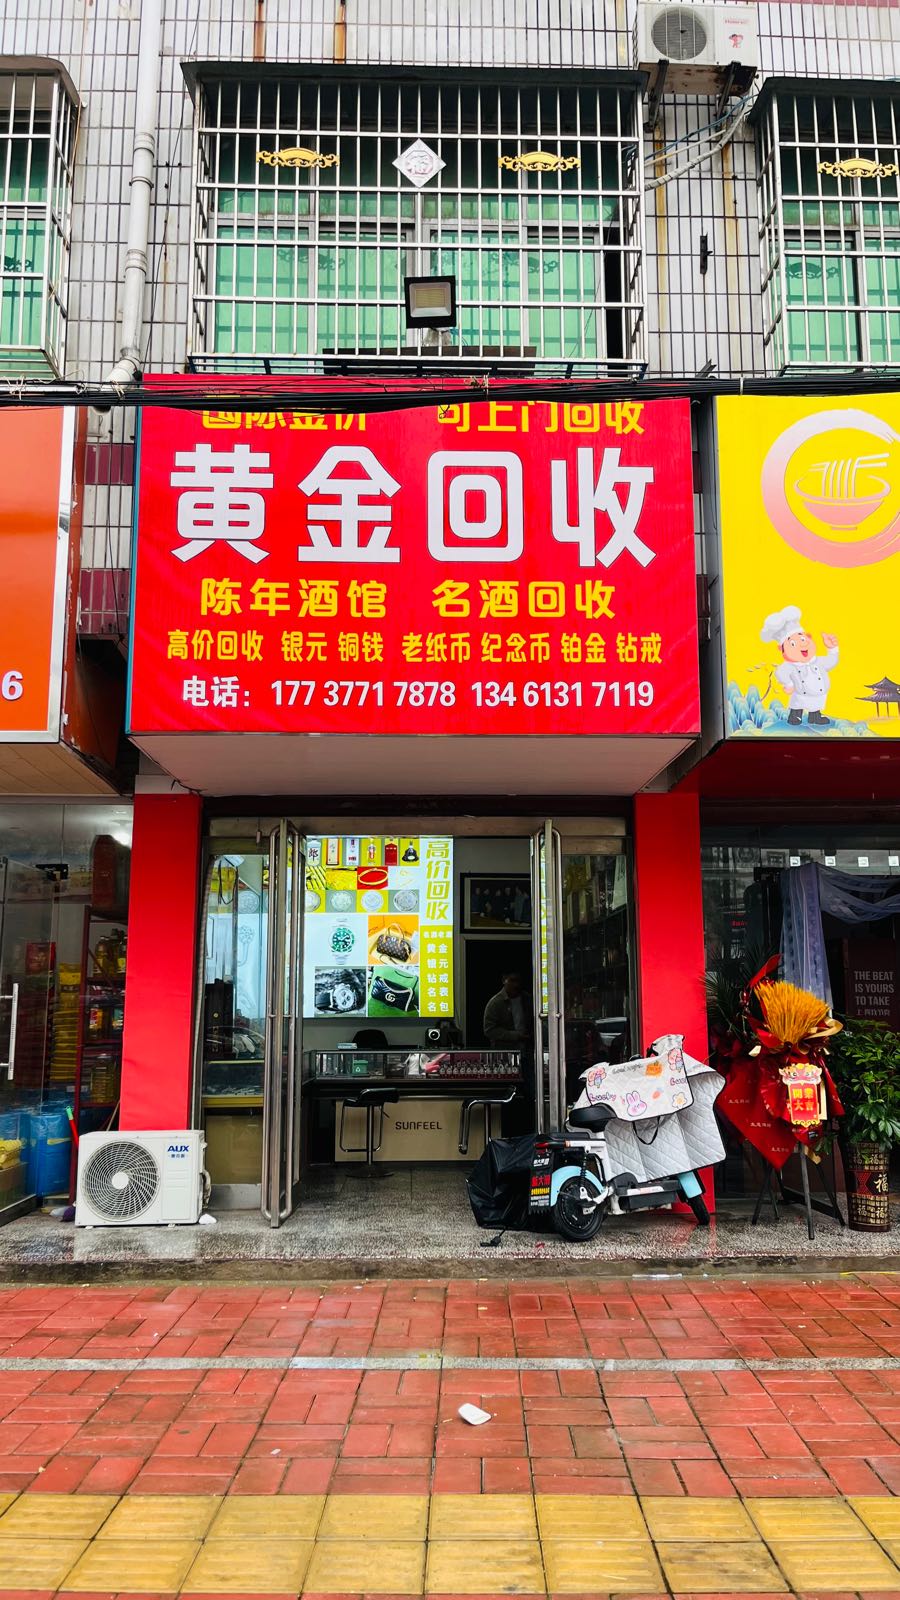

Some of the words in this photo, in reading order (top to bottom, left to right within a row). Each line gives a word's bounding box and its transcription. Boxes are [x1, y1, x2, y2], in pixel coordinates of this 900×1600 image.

[170, 443, 656, 568] 黄金回收
[200, 577, 387, 618] 陈年酒馆
[431, 579, 616, 619] 名酒回收
[167, 629, 264, 662] 高价回收
[281, 630, 328, 663] 银元
[337, 631, 384, 663] 铜钱
[401, 632, 471, 663] 老纸币
[480, 632, 550, 664] 纪念币
[560, 632, 607, 663] 铂金
[615, 632, 663, 664] 钻戒
[1, 670, 24, 700] 6
[271, 680, 316, 706] 177
[323, 680, 383, 707] 3771
[393, 680, 456, 707] 7878
[471, 681, 517, 707] 134
[523, 681, 582, 707] 6131
[591, 681, 654, 707] 7119
[426, 840, 450, 921] 高价回收
[427, 943, 448, 954] 黄金
[427, 959, 448, 969] 银元
[427, 973, 448, 984] 钻戒
[854, 970, 870, 981] THE
[872, 971, 894, 981] BEAT
[854, 983, 864, 993] IS
[865, 983, 895, 994] YOURS
[855, 995, 867, 1006] TO
[867, 996, 891, 1006] TAKE
[427, 1002, 448, 1012] 名包
[793, 1099, 815, 1111] 大吉
[395, 1121, 443, 1131] SUNFEEL
[167, 1145, 190, 1153] AUX
[873, 1173, 889, 1193] 福
